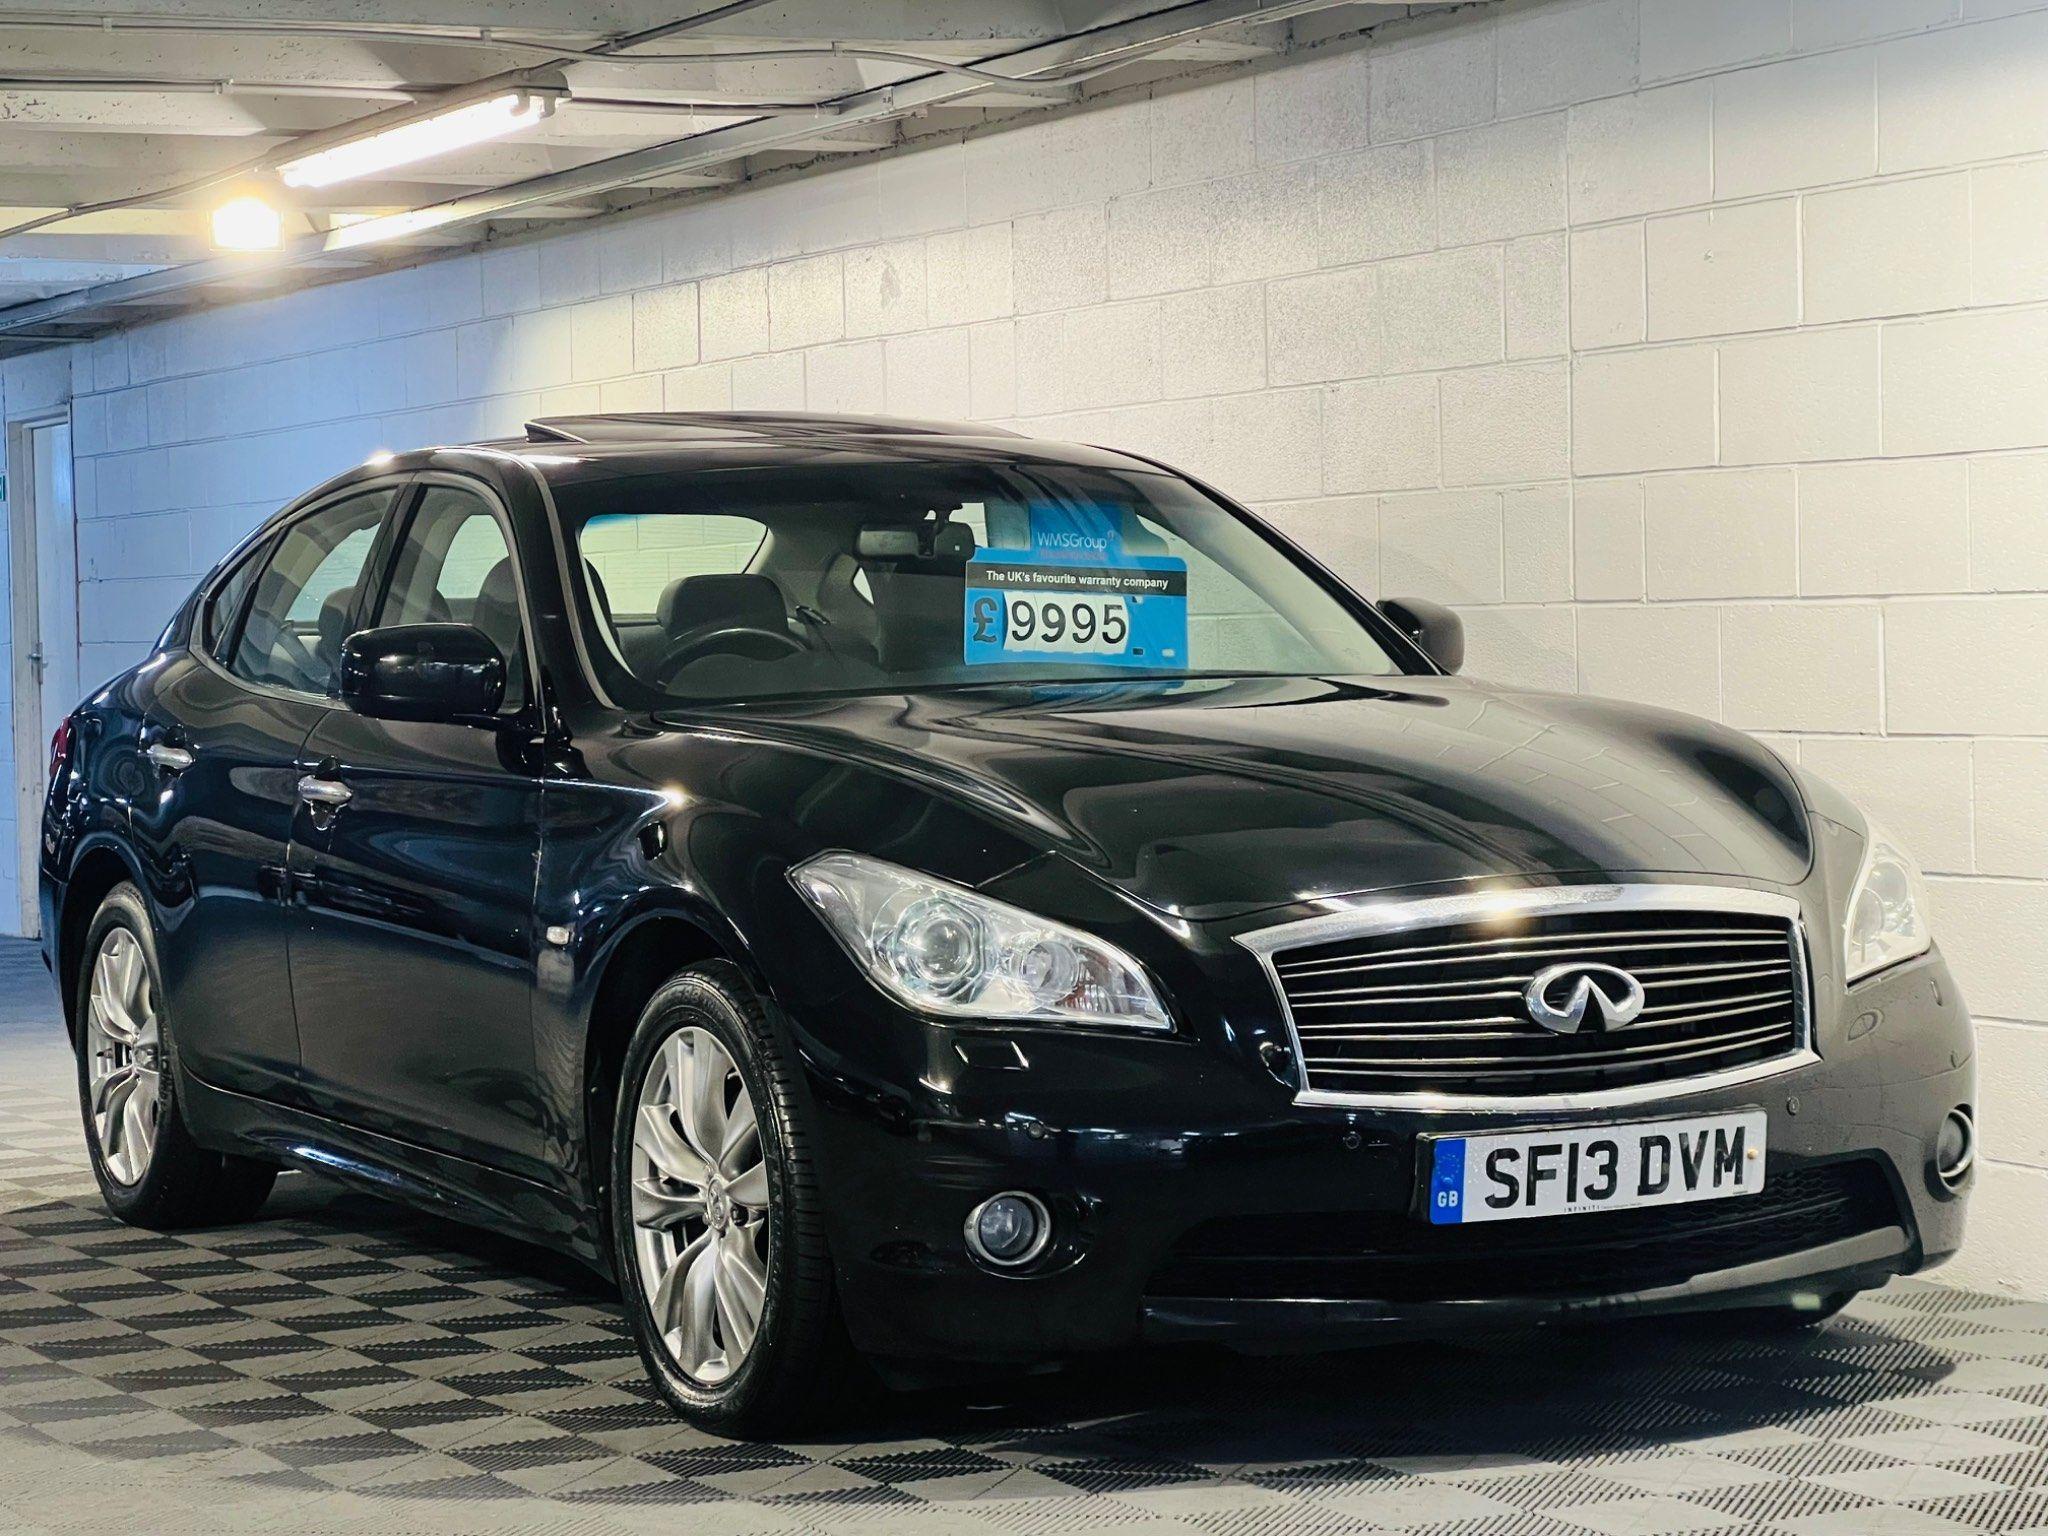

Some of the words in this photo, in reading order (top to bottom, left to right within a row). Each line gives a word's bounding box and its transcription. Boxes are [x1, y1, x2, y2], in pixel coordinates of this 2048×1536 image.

[1037, 532, 1107, 552] WMSGroup
[986, 570, 1005, 581] The
[1007, 571, 1031, 583] UK's
[1032, 572, 1076, 585] favourite
[1079, 576, 1121, 588] warranty
[1123, 578, 1169, 591] company
[1484, 1139, 1619, 1209] SF13
[1637, 1126, 1746, 1197] DVM
[1437, 1190, 1459, 1207] GB
